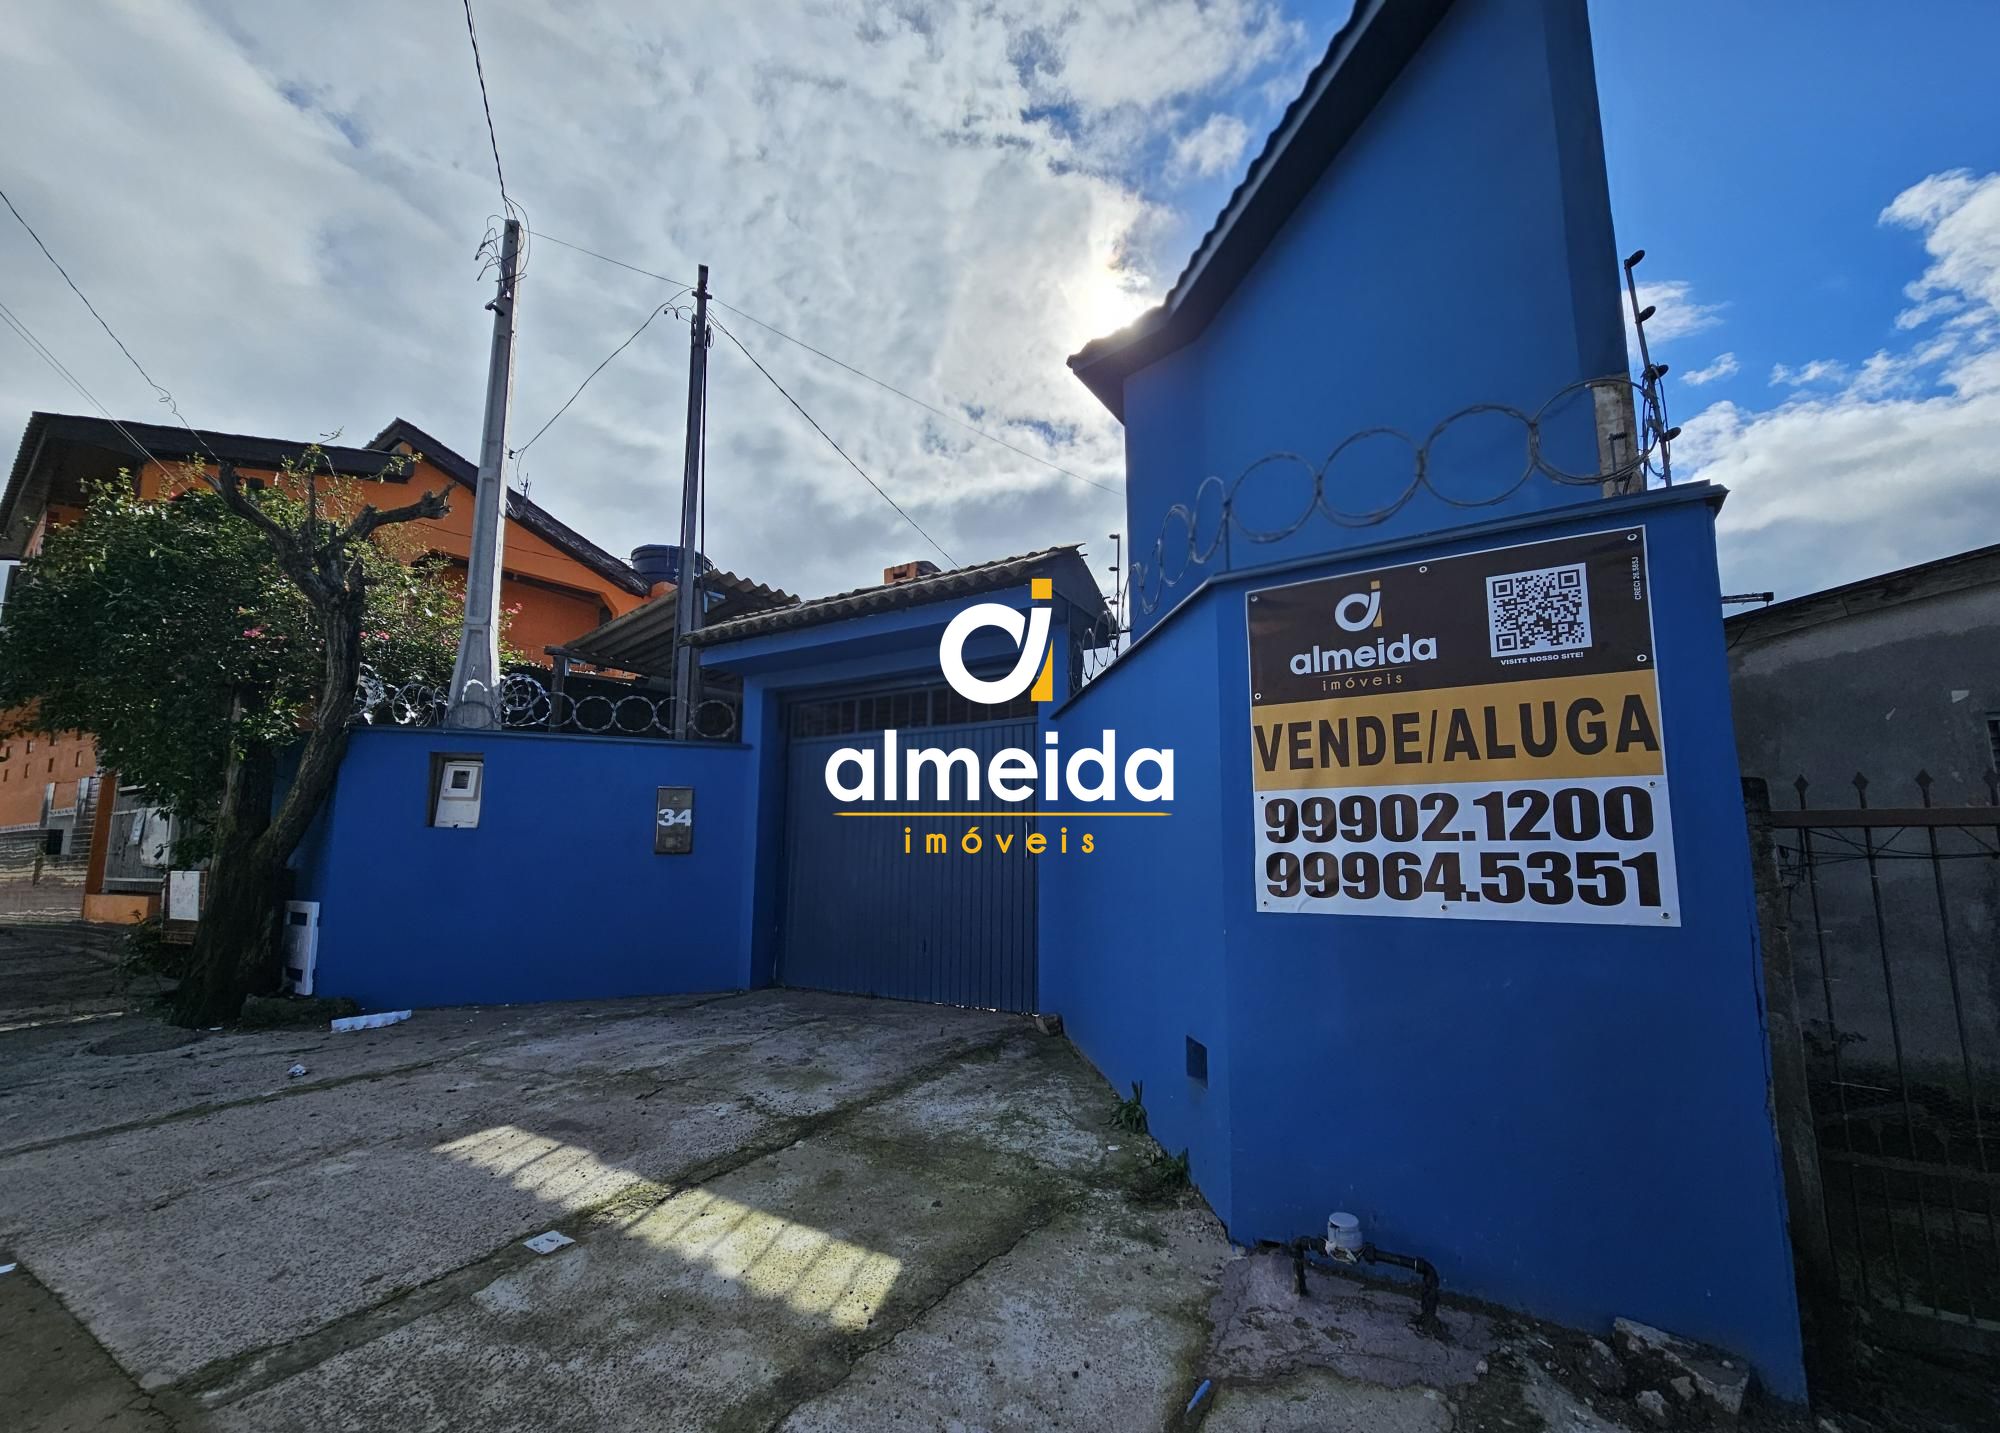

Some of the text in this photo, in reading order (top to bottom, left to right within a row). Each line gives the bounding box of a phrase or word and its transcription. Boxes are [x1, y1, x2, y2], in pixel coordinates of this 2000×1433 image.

[1633, 580, 1642, 600] CRECI
[1289, 633, 1438, 675] almeida
[1500, 651, 1584, 666] VISITE NOSSO SITE!
[1322, 673, 1403, 692] imóveis
[1253, 694, 1661, 772] VENDE/ALUGA
[658, 808, 692, 827] 34
[1264, 785, 1655, 844] 99902.1200
[1265, 851, 1662, 908] 99964.5351
